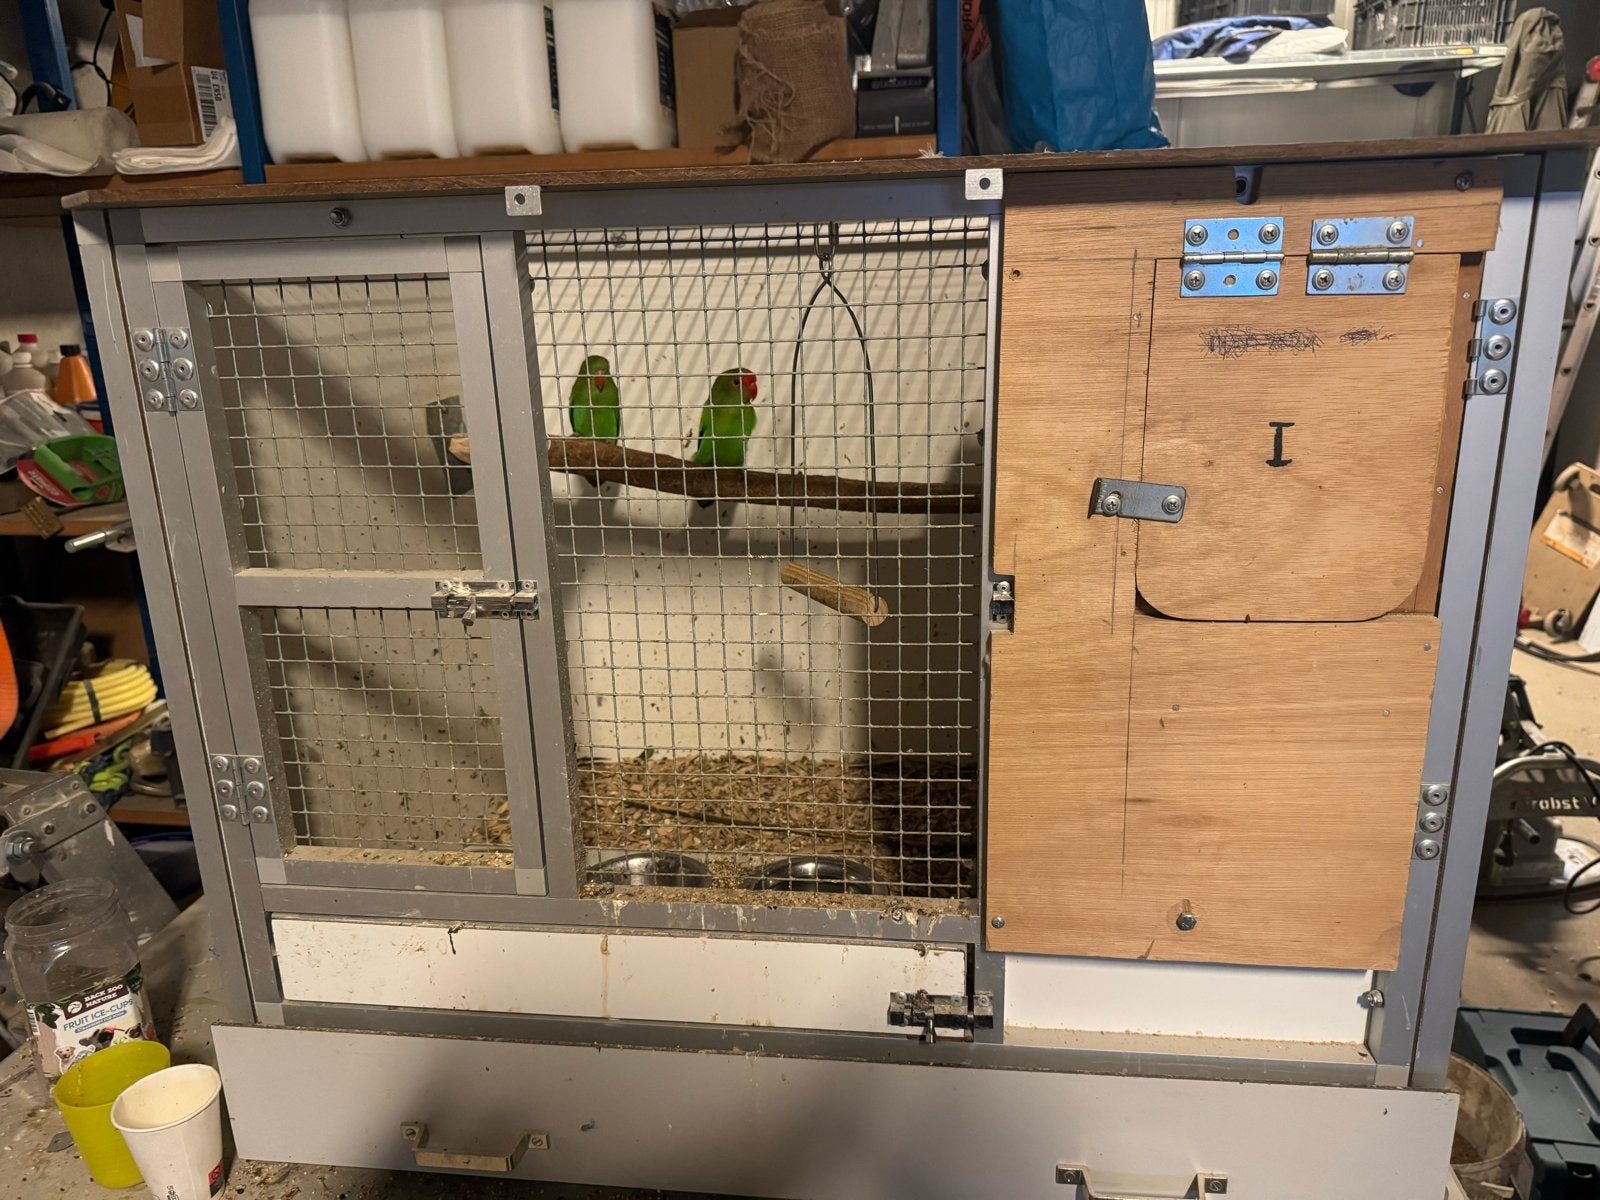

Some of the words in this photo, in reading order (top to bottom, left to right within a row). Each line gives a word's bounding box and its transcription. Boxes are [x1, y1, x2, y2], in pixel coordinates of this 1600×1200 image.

[1265, 421, 1295, 468] I
[84, 990, 106, 1003] BACK
[107, 984, 124, 995] ZOO
[85, 992, 118, 1008] NATURE
[63, 1015, 90, 1032] FRUIT
[91, 998, 133, 1020] ICE-CUPS
